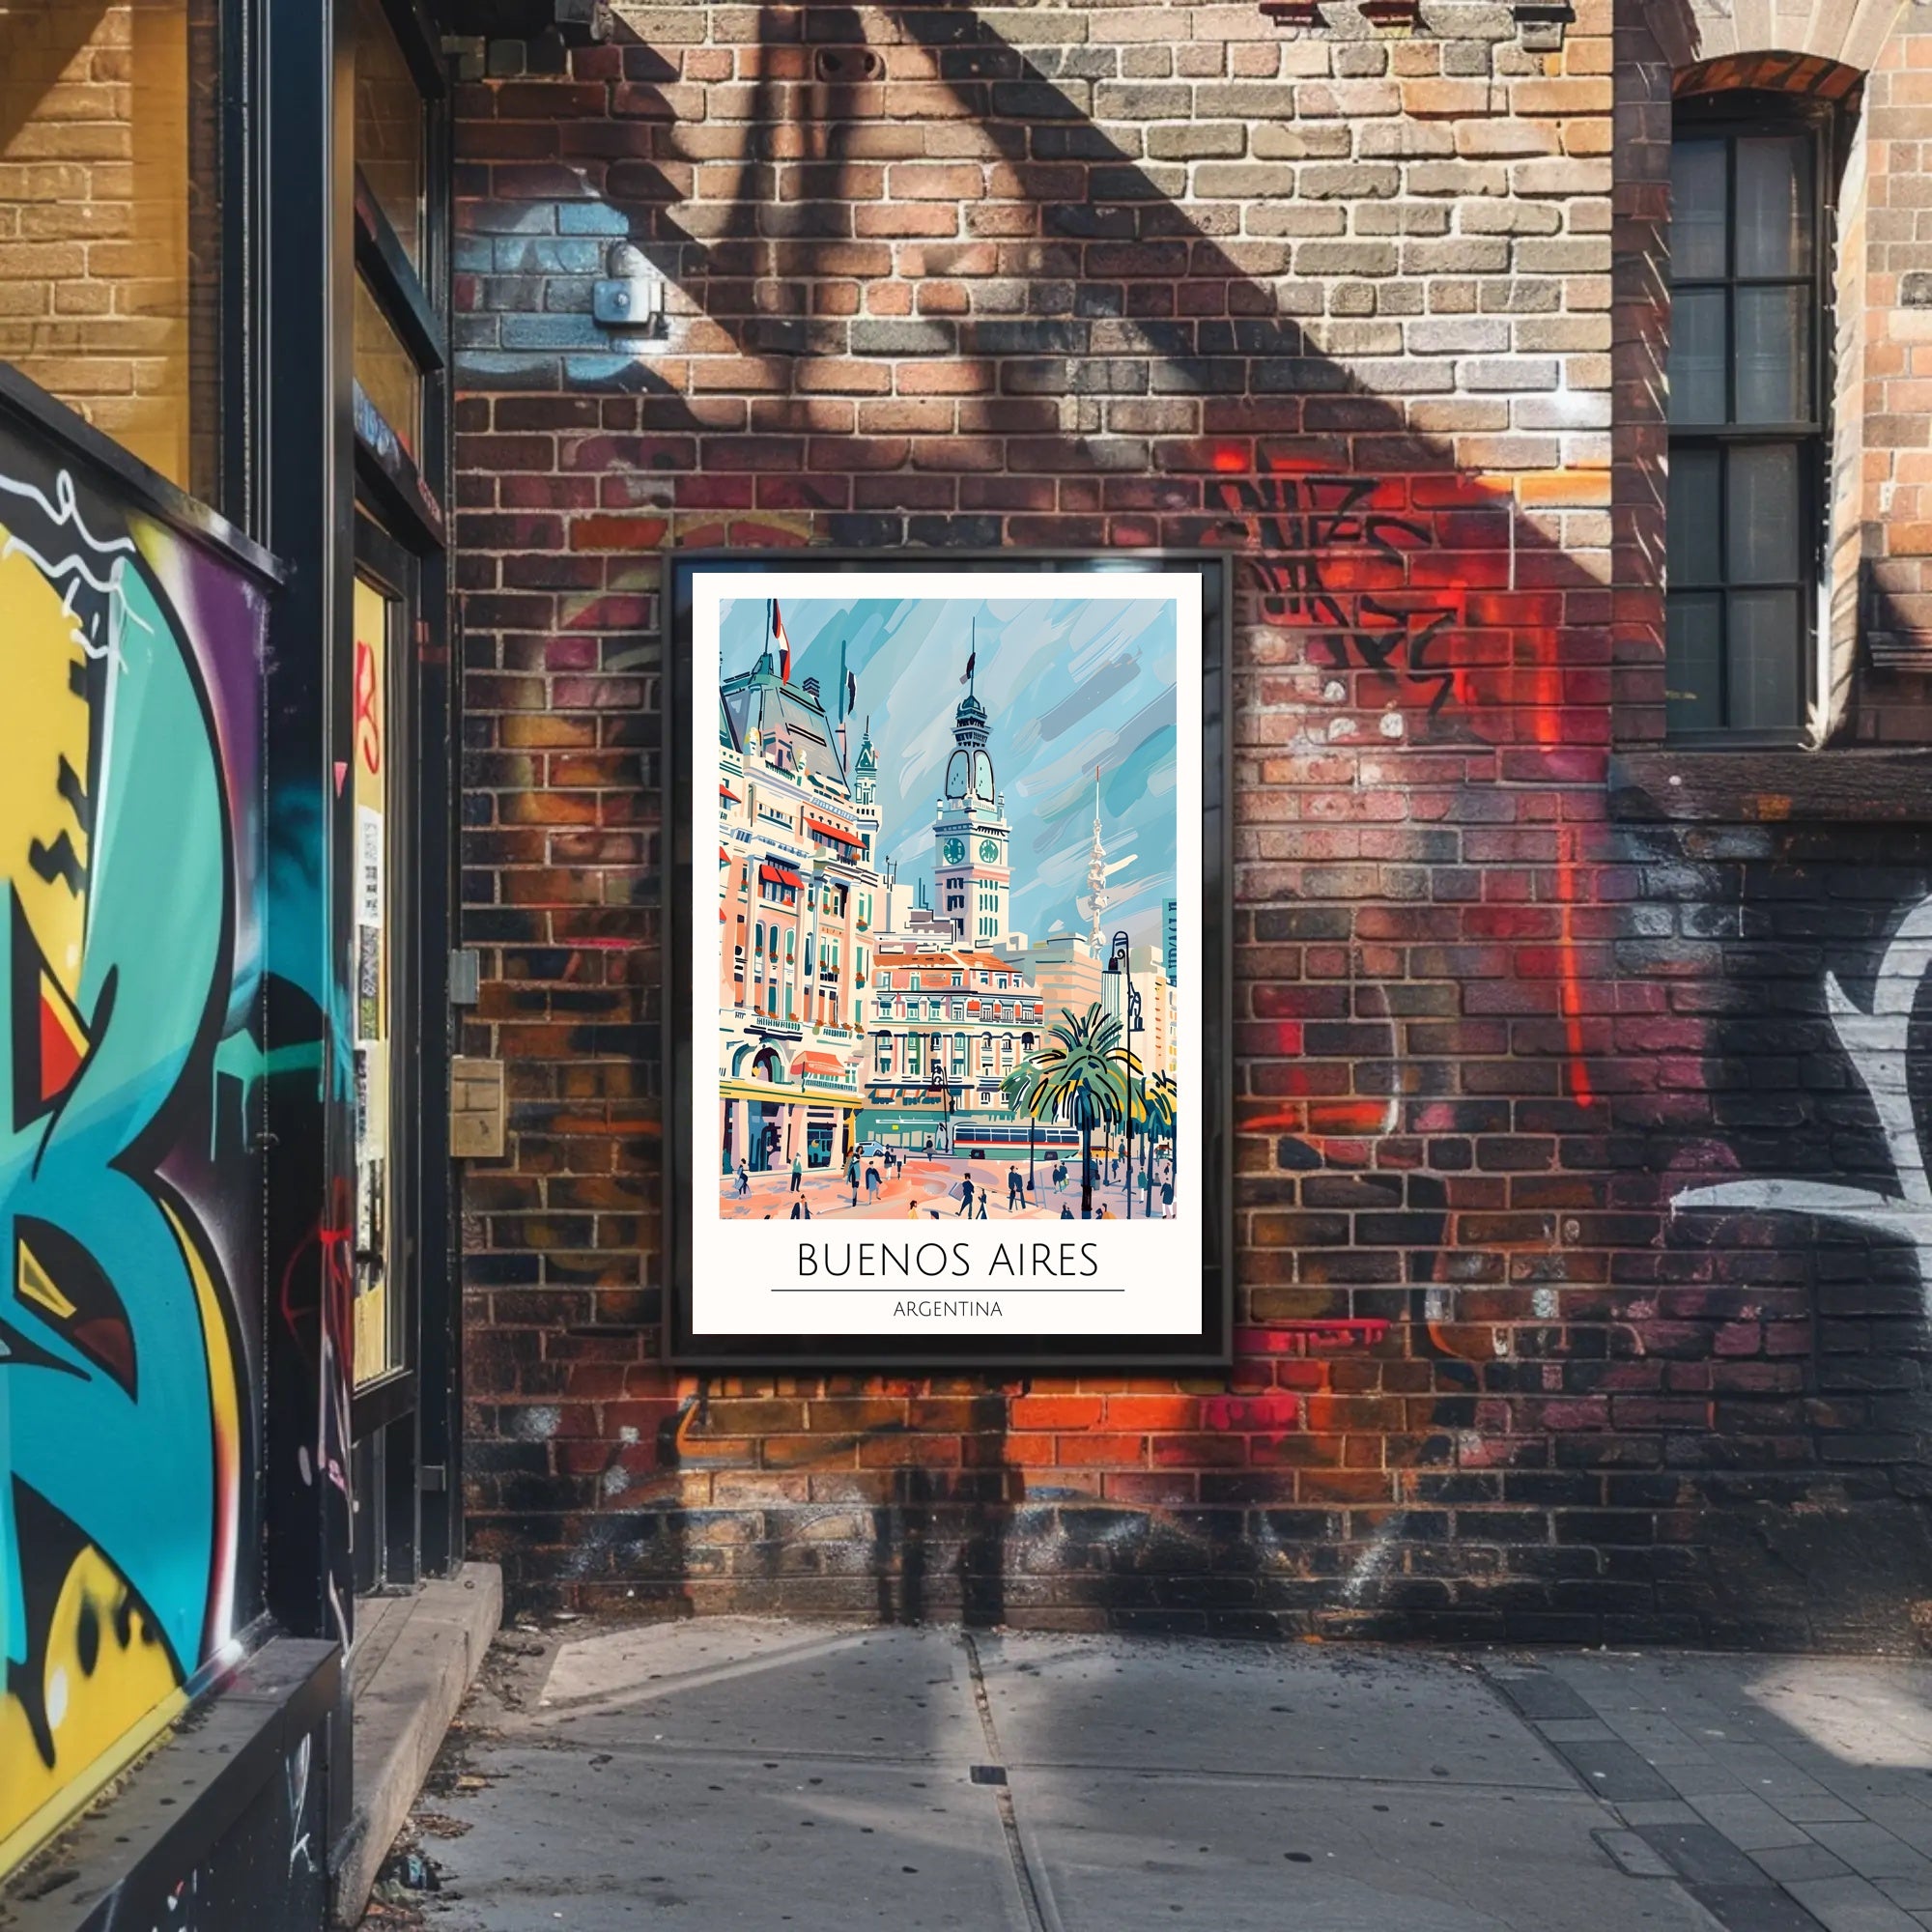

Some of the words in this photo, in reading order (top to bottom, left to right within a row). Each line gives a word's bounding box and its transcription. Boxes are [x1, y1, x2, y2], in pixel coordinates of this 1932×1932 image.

[798, 1242, 971, 1277] BUENOS
[987, 1242, 1099, 1277] AIRES
[893, 1300, 1004, 1318] ARGENTINA
